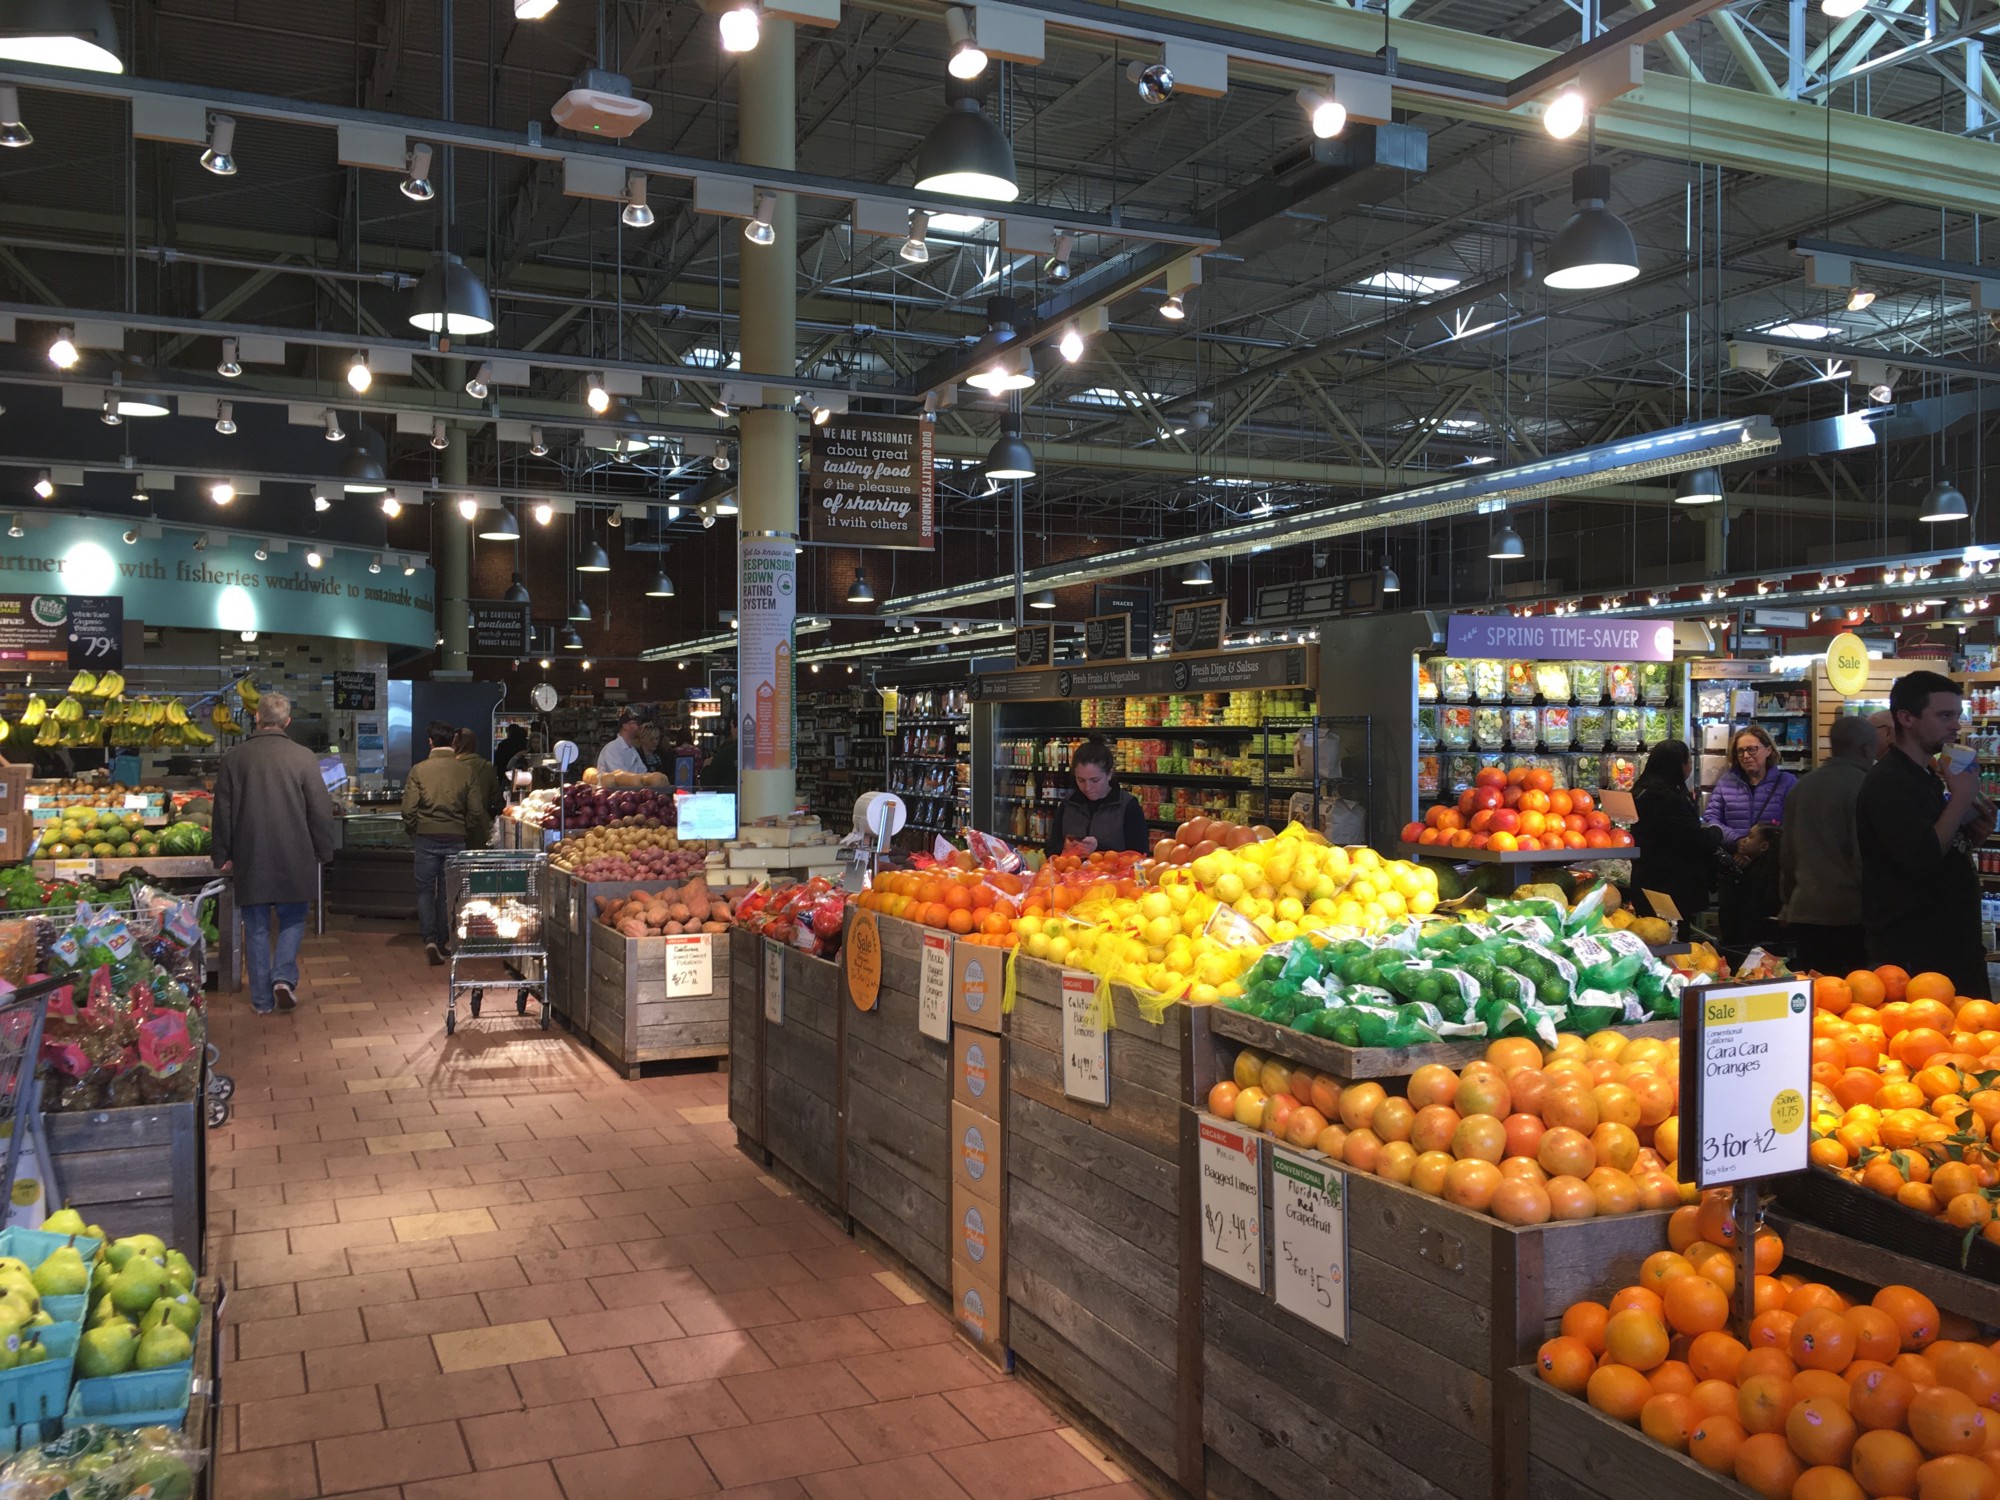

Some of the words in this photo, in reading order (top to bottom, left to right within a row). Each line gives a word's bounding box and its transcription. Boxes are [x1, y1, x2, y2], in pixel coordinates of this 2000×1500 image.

[822, 428, 836, 439] WE
[840, 429, 857, 440] ARE
[862, 430, 912, 445] PASSIONATE
[922, 431, 932, 448] OUR
[826, 443, 868, 457] about
[872, 449, 908, 460] great
[824, 460, 874, 479] tasting
[874, 462, 911, 480] food
[921, 450, 932, 486] QUALITY
[824, 478, 833, 489] &
[836, 479, 854, 490] the
[858, 481, 911, 494] pleasure
[822, 494, 844, 514] of
[844, 496, 911, 518] sharing
[922, 487, 932, 537] STANDARDS
[828, 515, 836, 527] it
[840, 516, 867, 528] with
[870, 519, 908, 531] others
[762, 548, 782, 556] know
[118, 558, 167, 580] with
[176, 560, 260, 587] fisheries
[265, 571, 342, 596] worldwide
[348, 584, 360, 598] to
[364, 587, 412, 607] sustainable
[744, 572, 774, 584] GROWN
[744, 585, 772, 596] RATING
[743, 598, 776, 610] SYSTEM
[478, 620, 522, 629] evaluate
[1487, 627, 1544, 647] SPRING
[1550, 628, 1639, 649] TIME-SAVER
[1192, 664, 1210, 676] Fresh
[1210, 662, 1226, 677] Dips
[1228, 661, 1235, 674] &
[1236, 660, 1259, 673] Salsas
[1838, 656, 1861, 670] Sale
[1072, 673, 1086, 684] Fresh
[1088, 672, 1103, 684] Fruits
[1104, 672, 1110, 682] &
[1110, 670, 1140, 684] Vegetables
[856, 932, 872, 954] Sale
[1064, 980, 1082, 988] ORGANIC
[1074, 1012, 1095, 1028] Bagged
[1708, 1004, 1736, 1020] Sale
[1706, 1028, 1743, 1038] Conventional
[1706, 1036, 1734, 1046] California
[1706, 1046, 1737, 1061] Cara
[1738, 1042, 1768, 1057] Cara
[1706, 1060, 1761, 1078] Oranges
[1776, 1094, 1800, 1106] Save
[1201, 1128, 1227, 1143] ORGANIC
[1703, 1137, 1720, 1162] 3
[1722, 1132, 1753, 1158] for
[1754, 1128, 1778, 1154] $2
[1204, 1164, 1234, 1187] Bagged
[1276, 1161, 1322, 1185] CONVENTIONAL
[1298, 1198, 1314, 1212] Red
[1286, 1203, 1331, 1235] Grapefruit
[1282, 1240, 1294, 1262] 5
[1293, 1257, 1308, 1277] for
